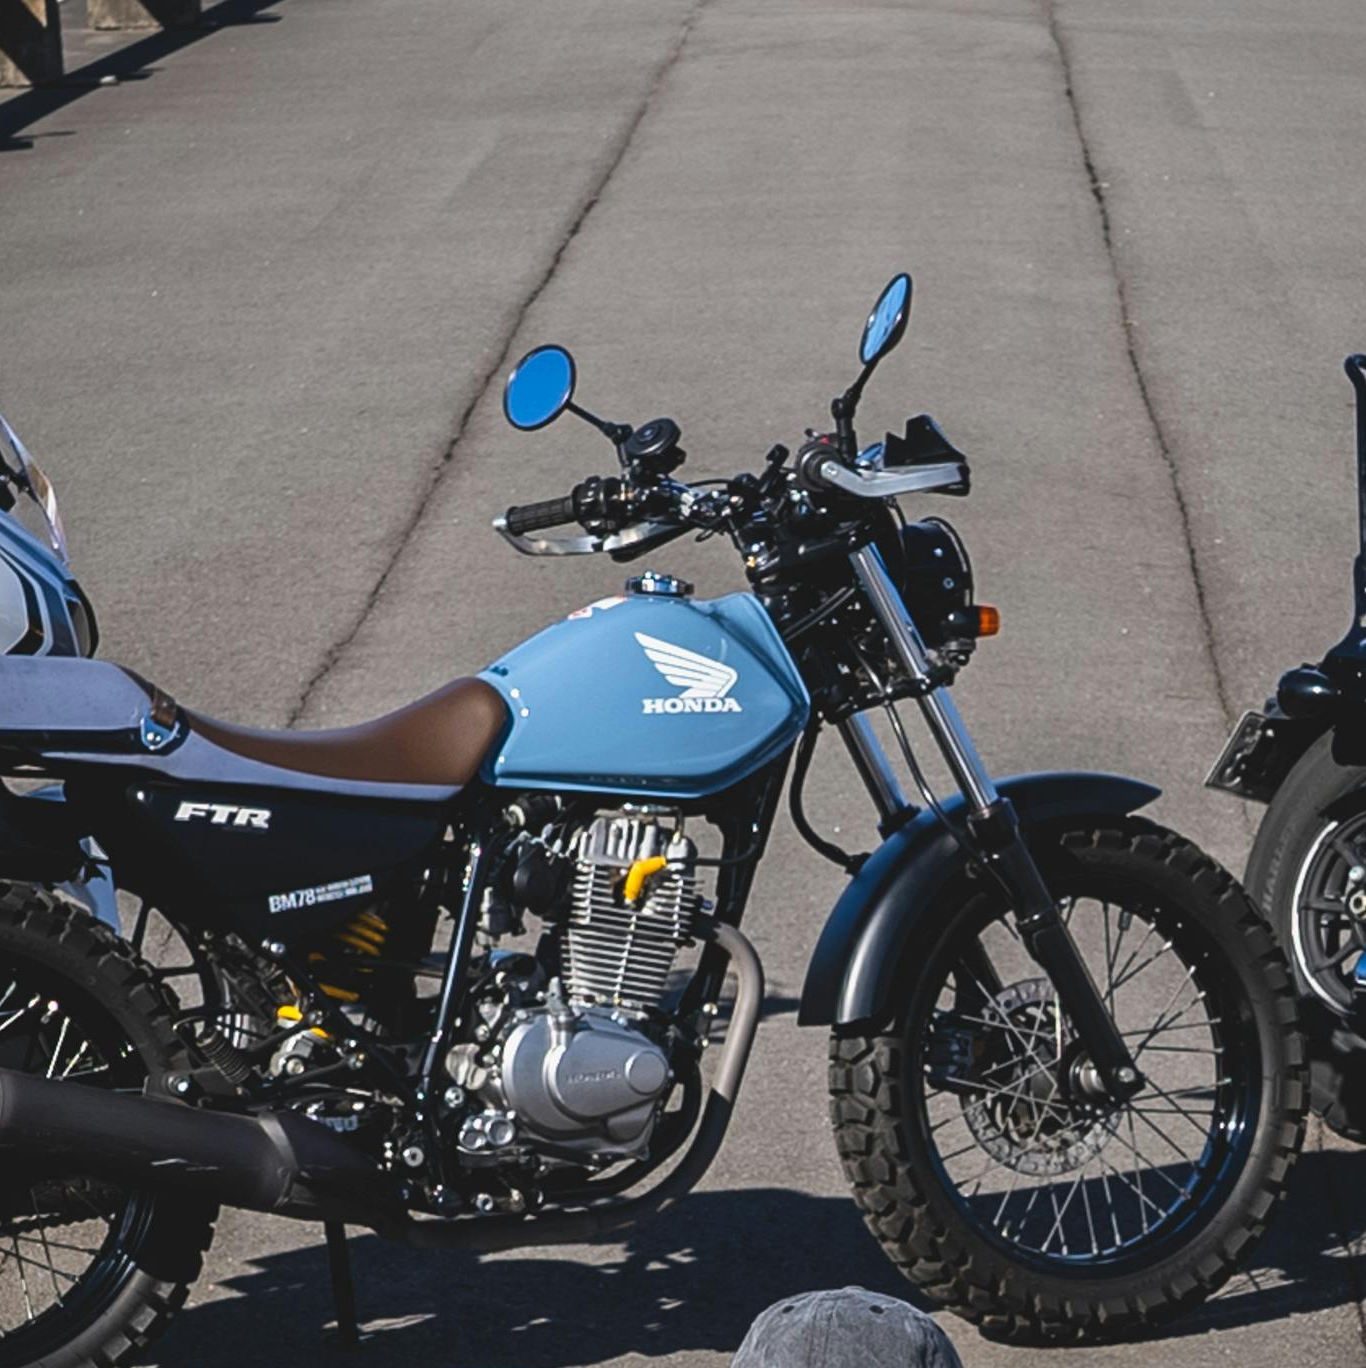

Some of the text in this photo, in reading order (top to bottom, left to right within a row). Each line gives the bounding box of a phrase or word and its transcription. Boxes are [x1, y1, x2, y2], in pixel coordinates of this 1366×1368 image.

[642, 698, 742, 714] HONDA
[174, 801, 271, 829] FTR
[269, 888, 316, 913] BM78
